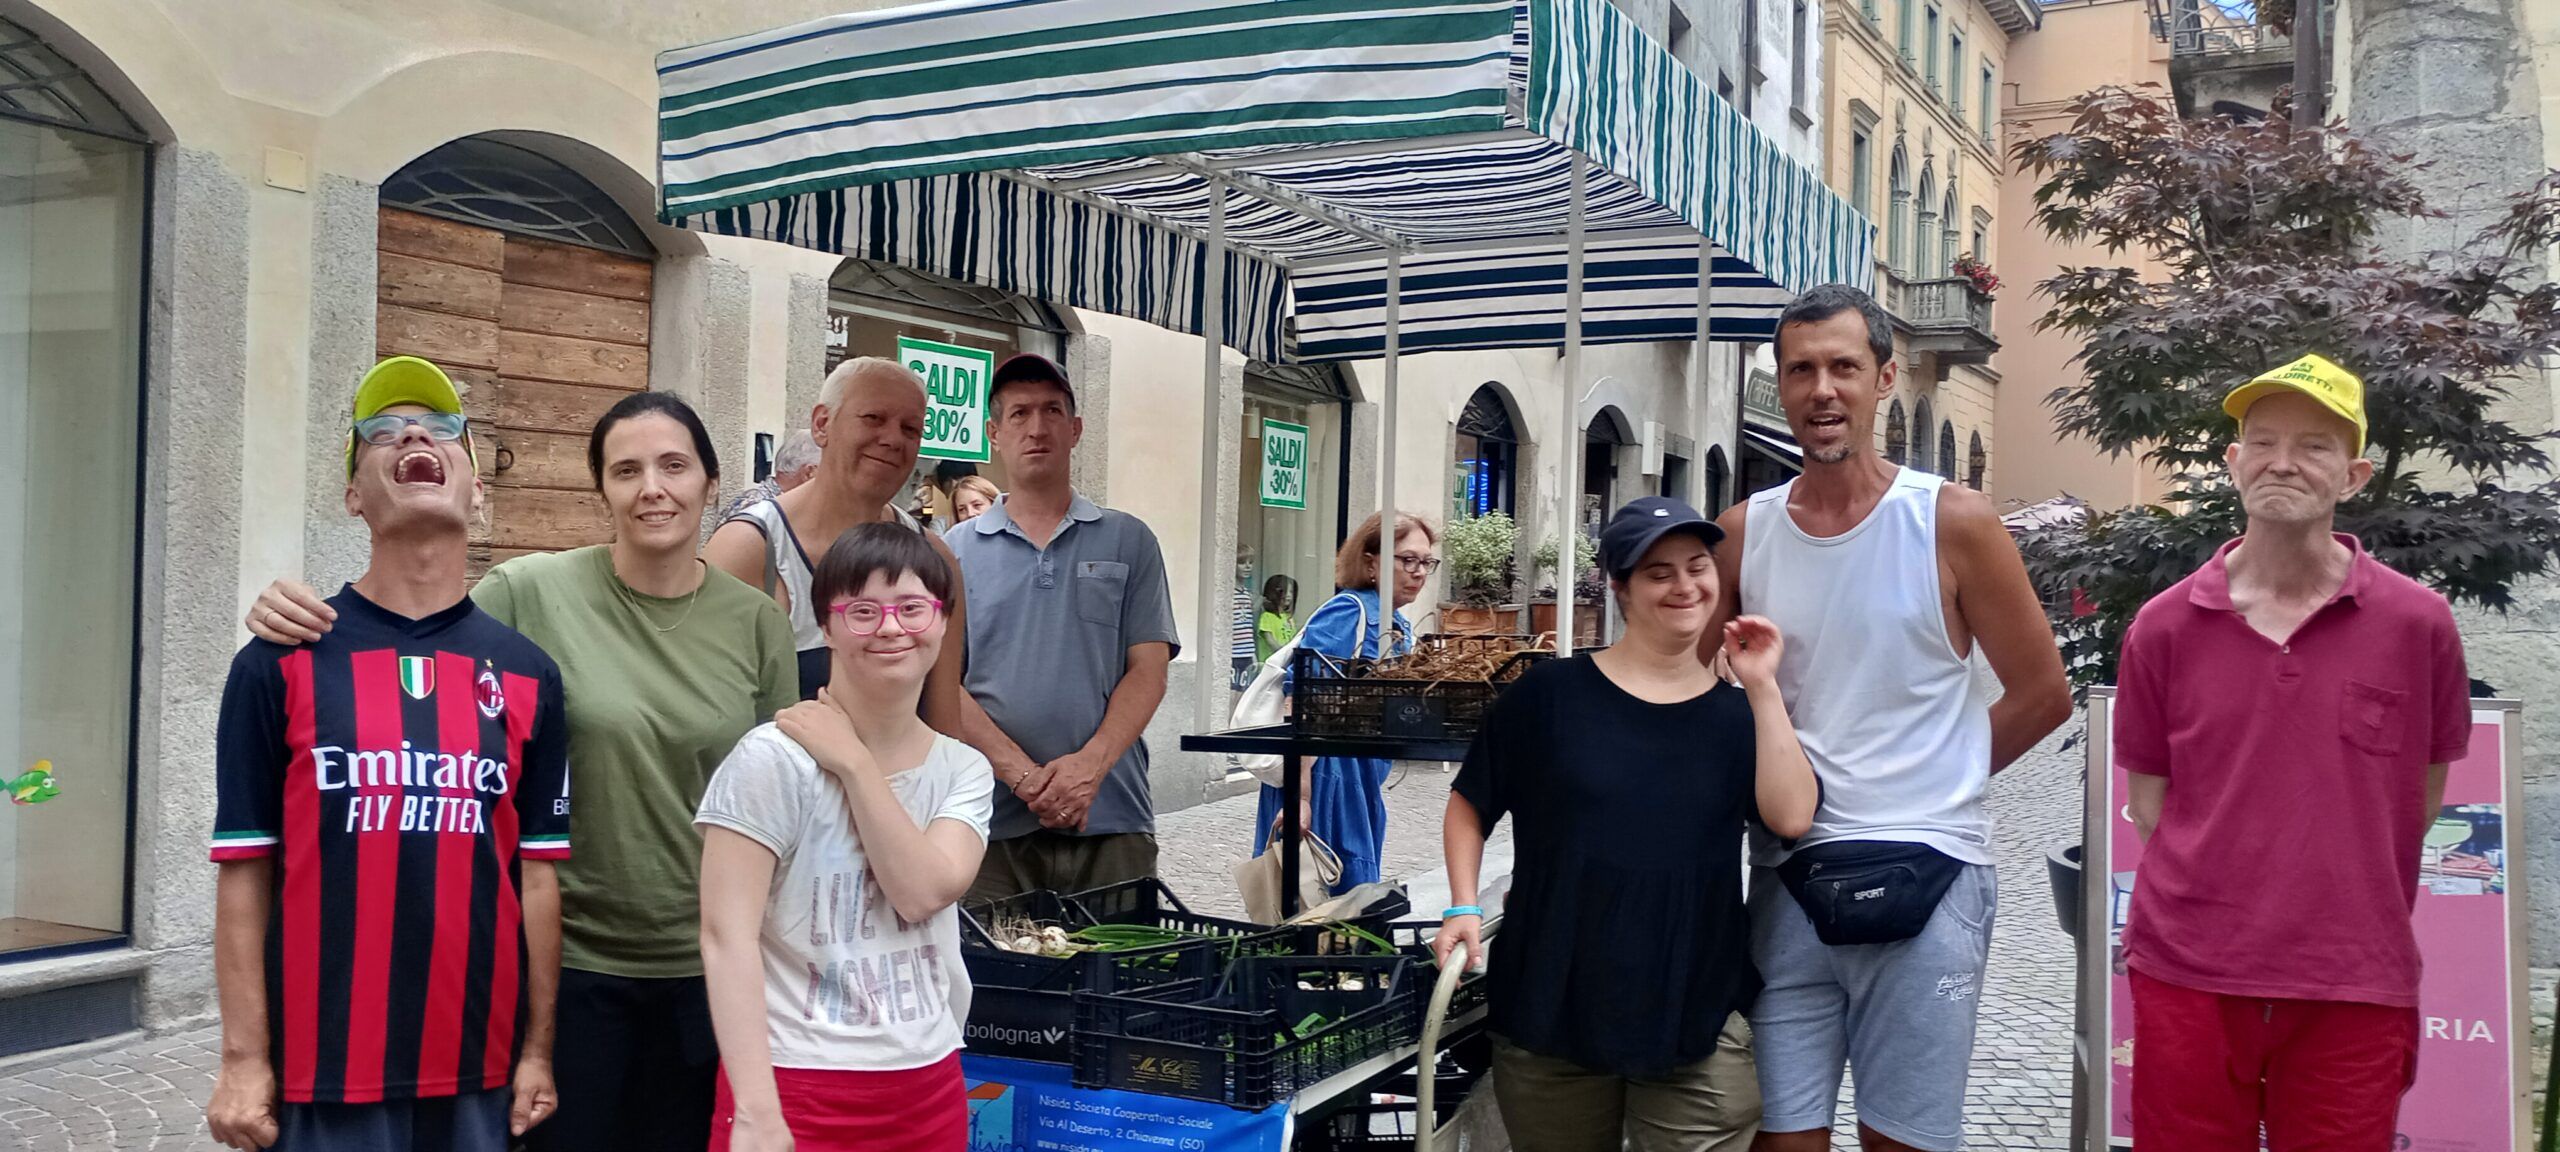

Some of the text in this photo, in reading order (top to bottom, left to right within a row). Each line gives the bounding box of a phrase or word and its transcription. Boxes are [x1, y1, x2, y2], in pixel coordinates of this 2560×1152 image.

[1267, 434, 1302, 469] SALDI
[311, 740, 508, 795] Emirates
[346, 795, 393, 833] FLY
[1854, 887, 1885, 900] SPORT
[967, 1021, 1042, 1045] bologna
[1039, 1094, 1071, 1110] Nisida
[1113, 1106, 1175, 1125] Cooperativa
[1178, 1115, 1214, 1130] Sociale
[1039, 1115, 1205, 1151] Via Al Deserto, 2 Chiavenna (SO)
